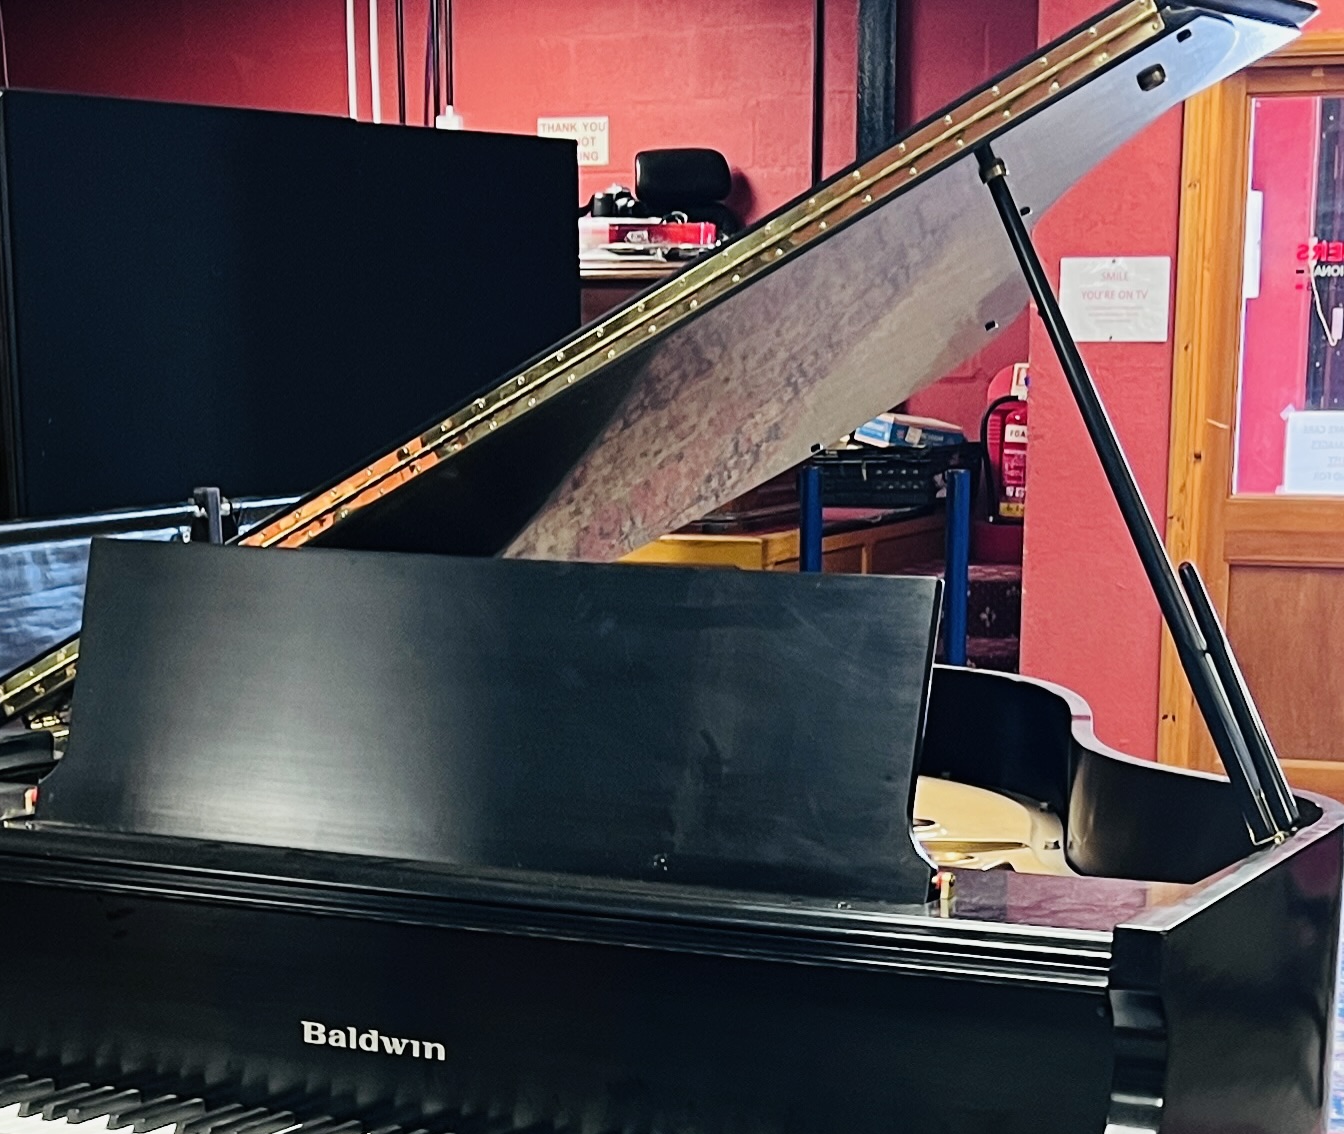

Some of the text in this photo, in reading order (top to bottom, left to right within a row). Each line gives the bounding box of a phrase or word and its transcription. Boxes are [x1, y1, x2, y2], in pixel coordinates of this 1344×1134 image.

[540, 121, 606, 133] THANK YOU
[1101, 271, 1129, 281] SMILE
[1081, 288, 1149, 300] YOU'RE ON TV
[301, 1020, 446, 1061] Baldwin
